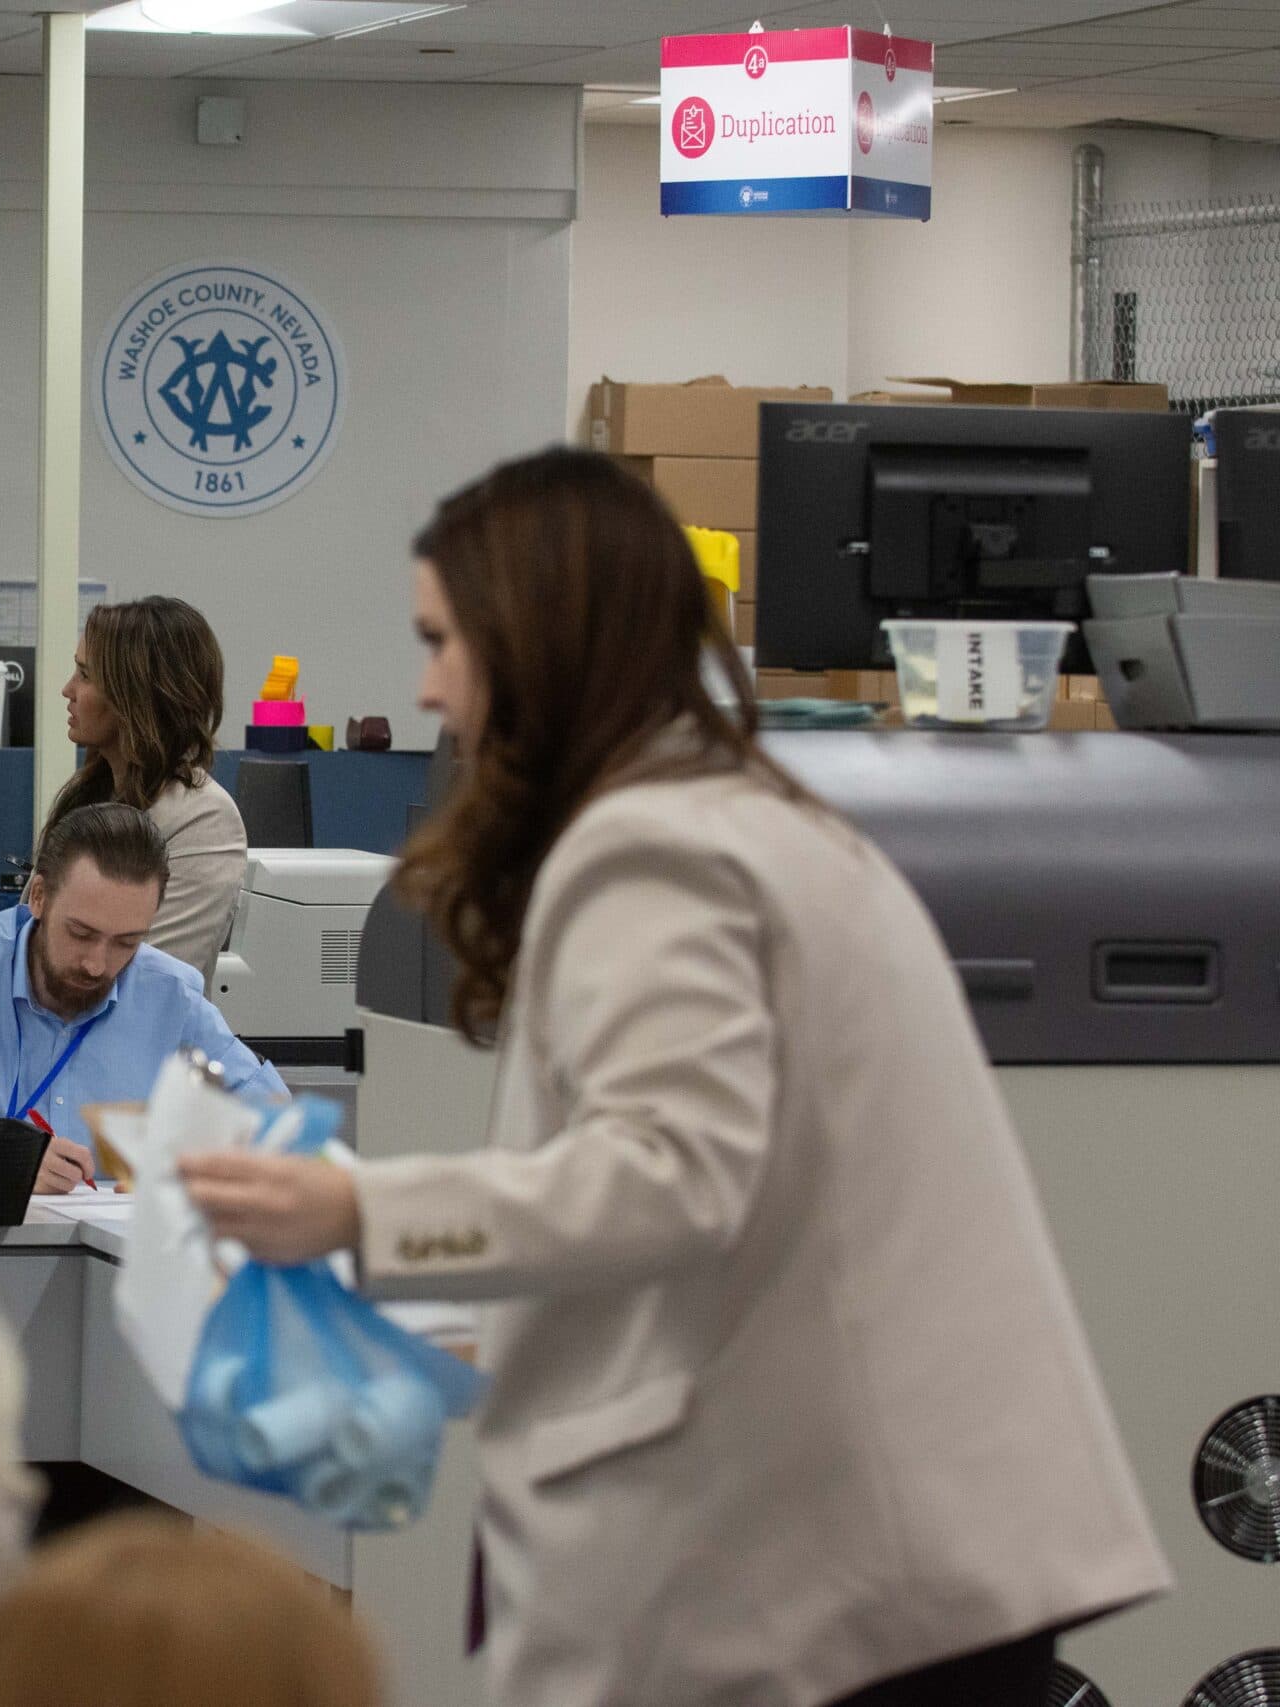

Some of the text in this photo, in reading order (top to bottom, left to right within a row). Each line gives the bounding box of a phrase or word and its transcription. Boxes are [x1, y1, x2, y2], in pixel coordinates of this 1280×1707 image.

[721, 109, 835, 142] Duplication
[118, 283, 321, 388] WASHOE COUNTY, NEVADA
[785, 419, 870, 442] acer
[193, 470, 245, 493] 1861
[968, 633, 983, 710] INTAKE
